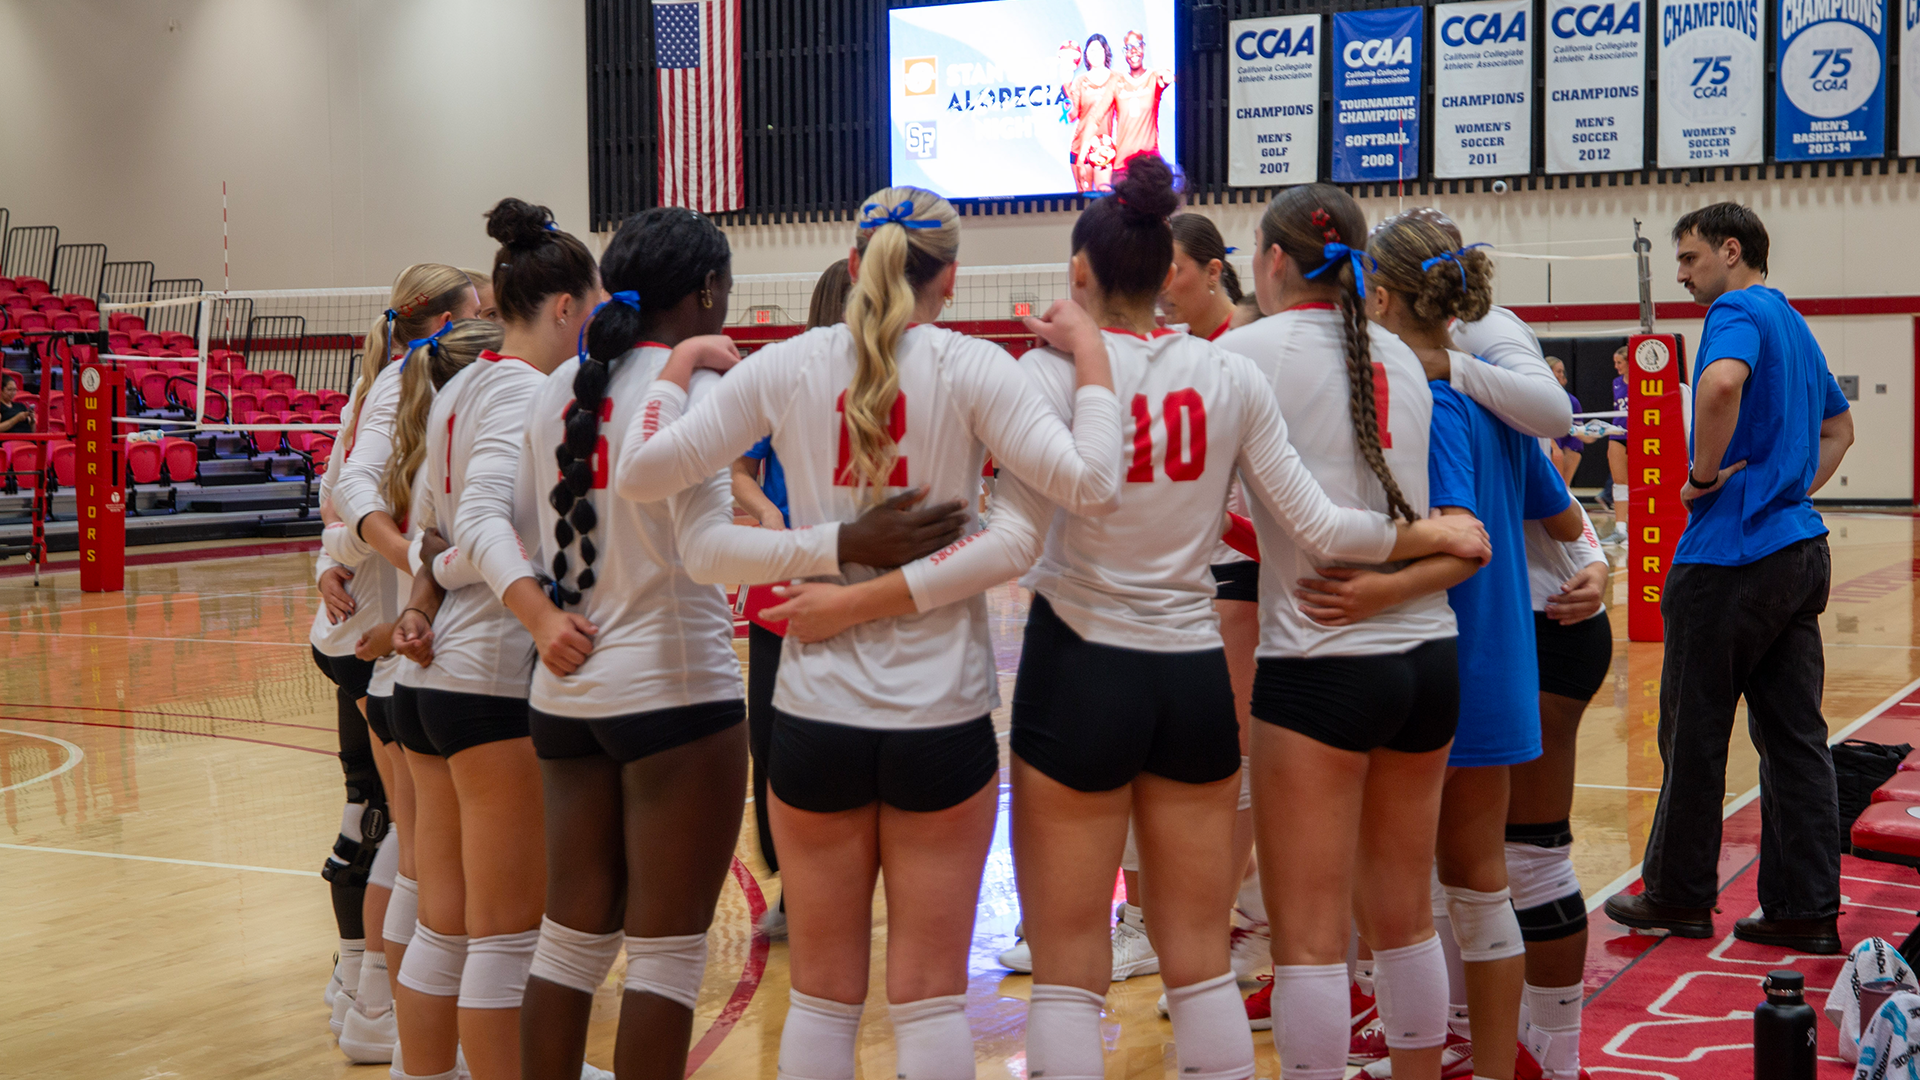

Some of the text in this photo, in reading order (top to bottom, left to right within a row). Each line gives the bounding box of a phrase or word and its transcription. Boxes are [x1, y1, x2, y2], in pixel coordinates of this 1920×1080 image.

[1551, 1, 1641, 39] CCAA
[1664, 0, 1758, 47] CHAMPIONS
[1782, 0, 1882, 41] CHAMPIONS
[1441, 10, 1526, 47] CCAA
[1235, 26, 1315, 61] CCAA
[1553, 40, 1639, 55] California Collegiate
[1342, 36, 1413, 68] CCAA
[1443, 49, 1524, 62] California Collegiate
[1553, 50, 1639, 64] Athletic Association
[1237, 62, 1313, 75] California Collegiate
[1443, 57, 1524, 71] Athletic Association
[1691, 55, 1732, 86] 75
[1810, 48, 1853, 79] 75
[1237, 71, 1313, 83] Athletic Association
[1345, 67, 1410, 80] California Collegiate
[1345, 74, 1410, 87] Athletic Association
[1813, 77, 1848, 92] CCAA
[1552, 86, 1640, 102] CHAMPIONS
[1694, 85, 1728, 99] CCAA
[1340, 96, 1416, 110] TOURNAMENT
[1442, 92, 1525, 108] CHAMPIONS
[1236, 104, 1314, 119] CHAMPIONS
[1339, 108, 1416, 124] CHAMPIONS
[1454, 121, 1511, 134] WOMEN'S
[1575, 117, 1615, 128] MEN'S
[1810, 119, 1850, 132] MEN'S
[1257, 133, 1292, 144] MEN'S
[1572, 131, 1619, 143] SOCCER
[1682, 126, 1737, 138] WOMEN'S
[1793, 129, 1867, 144] BASKETBALL
[1345, 133, 1410, 148] SOFTBALL
[1461, 136, 1505, 148] SOCCER
[1688, 137, 1731, 149] SOCCER
[1261, 147, 1288, 158] GOLF
[1579, 148, 1611, 162] 2012
[1689, 148, 1730, 160] 2013-14
[1808, 142, 1852, 155] 2013-14
[1361, 154, 1395, 168] 2008
[1468, 153, 1498, 166] 2011
[1260, 162, 1290, 174] 2007
[1126, 387, 1207, 483] 10
[84, 397, 98, 564] WARRIORS
[1640, 378, 1664, 604] WARRIORS
